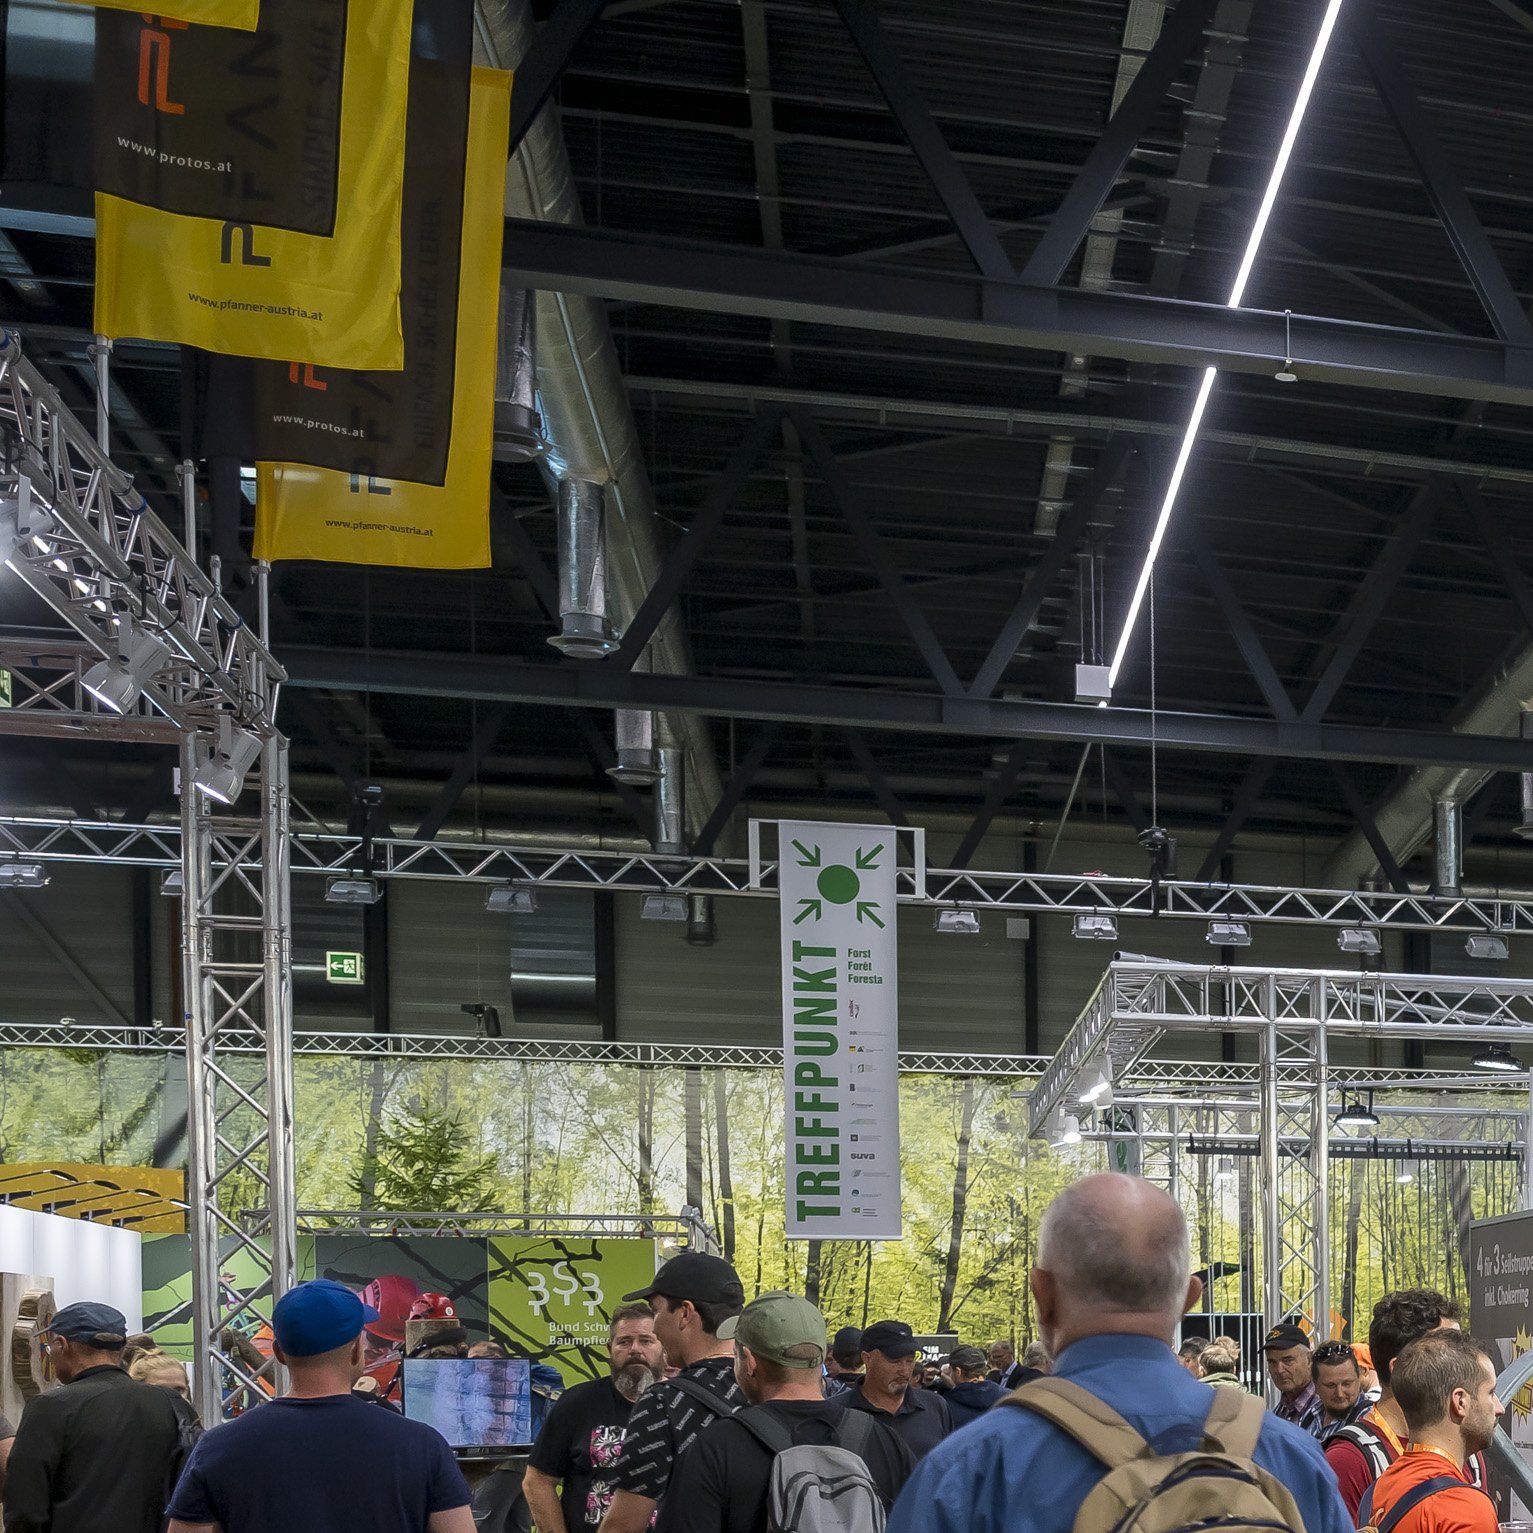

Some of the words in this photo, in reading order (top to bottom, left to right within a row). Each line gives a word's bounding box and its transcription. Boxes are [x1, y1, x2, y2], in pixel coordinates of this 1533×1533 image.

[117, 136, 232, 173] www.protos.at
[188, 292, 323, 322] www.pfanner-austria.at
[273, 413, 366, 439] www.protos.at
[325, 518, 434, 538] www.pfanner-austria.at
[848, 948, 871, 958] Forst
[848, 961, 873, 971] Forêt
[848, 974, 883, 984] Foresta
[792, 940, 841, 1222] TREFFPUNKT
[1476, 1246, 1483, 1278] 4
[1484, 1256, 1493, 1277] für
[1493, 1243, 1500, 1276] 3
[1497, 1283, 1529, 1308] Chokerring
[549, 1322, 580, 1332] Bund
